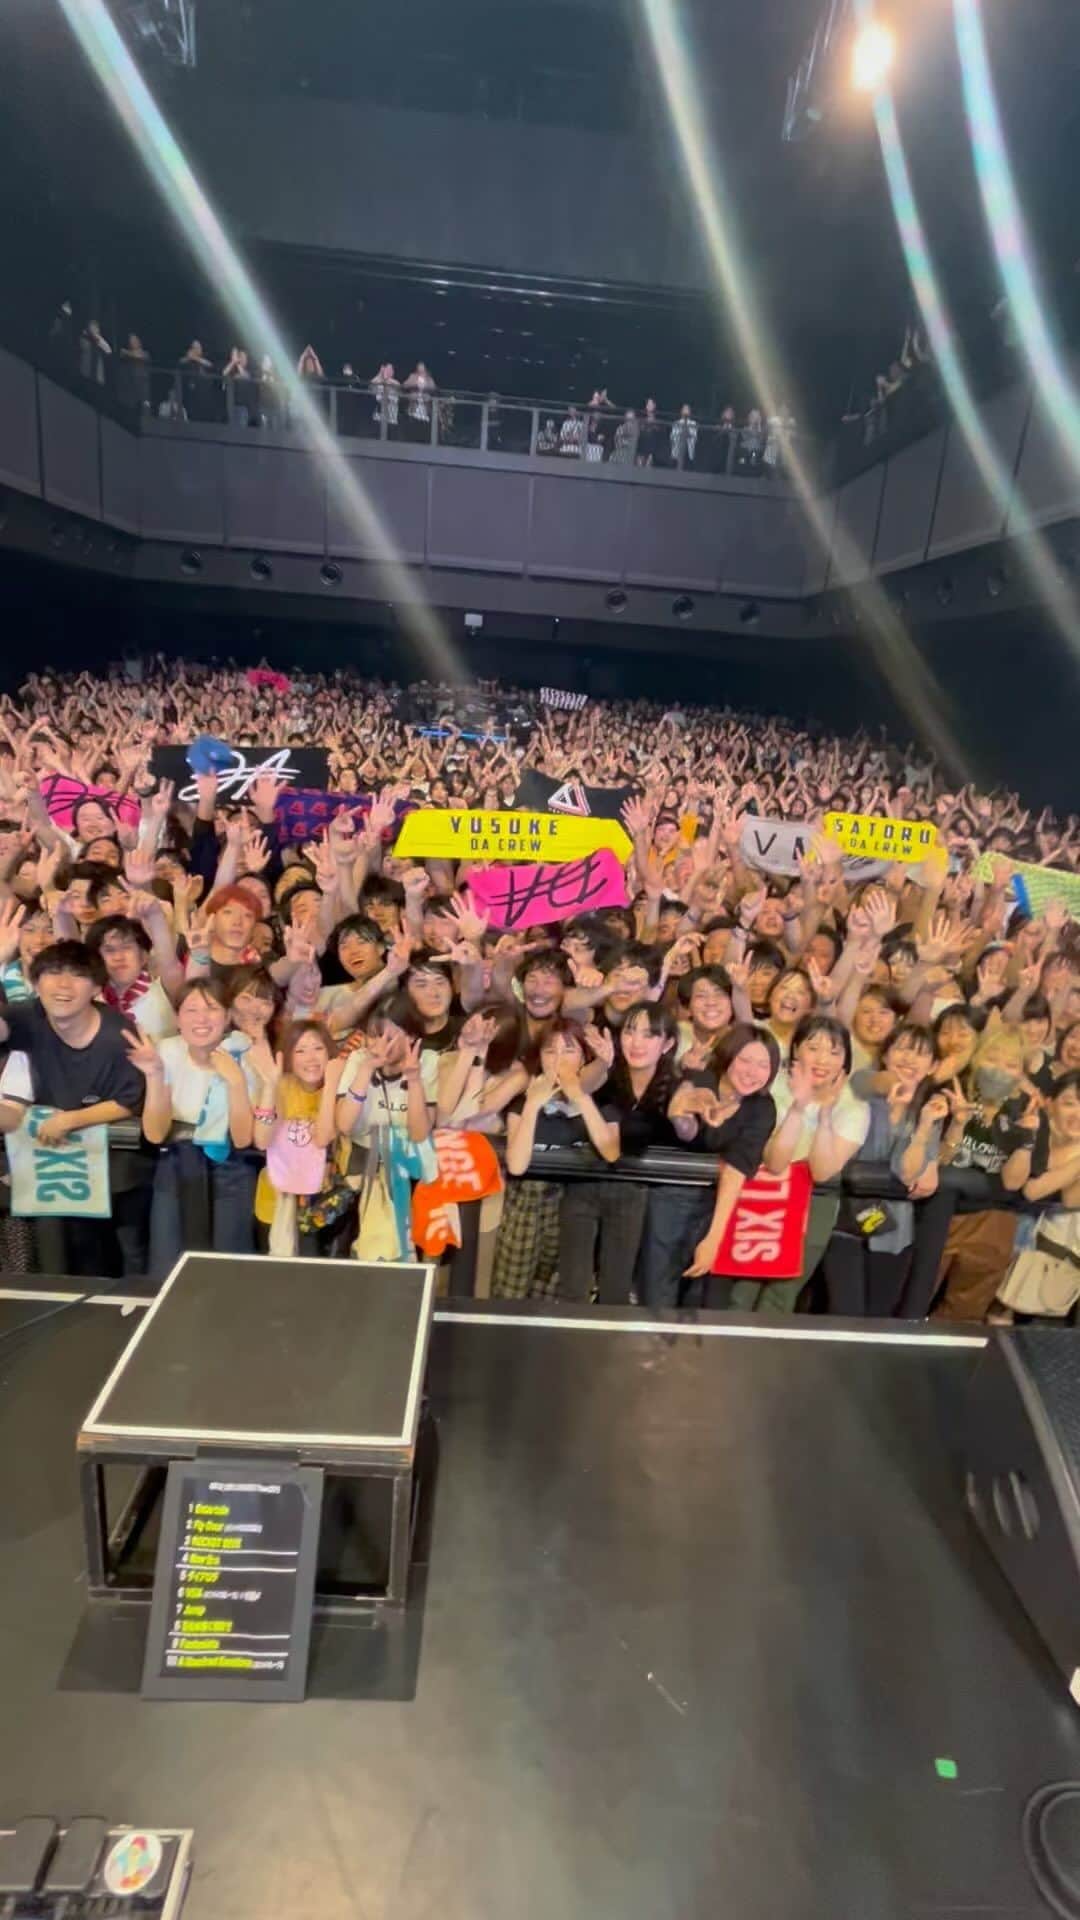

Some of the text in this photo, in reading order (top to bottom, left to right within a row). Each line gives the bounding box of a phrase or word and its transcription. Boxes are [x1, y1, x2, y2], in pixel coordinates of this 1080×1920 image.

[450, 816, 559, 836] YUSUKE
[834, 818, 931, 844] SATORU
[498, 839, 542, 852] CREW
[731, 1207, 787, 1263] SIX
